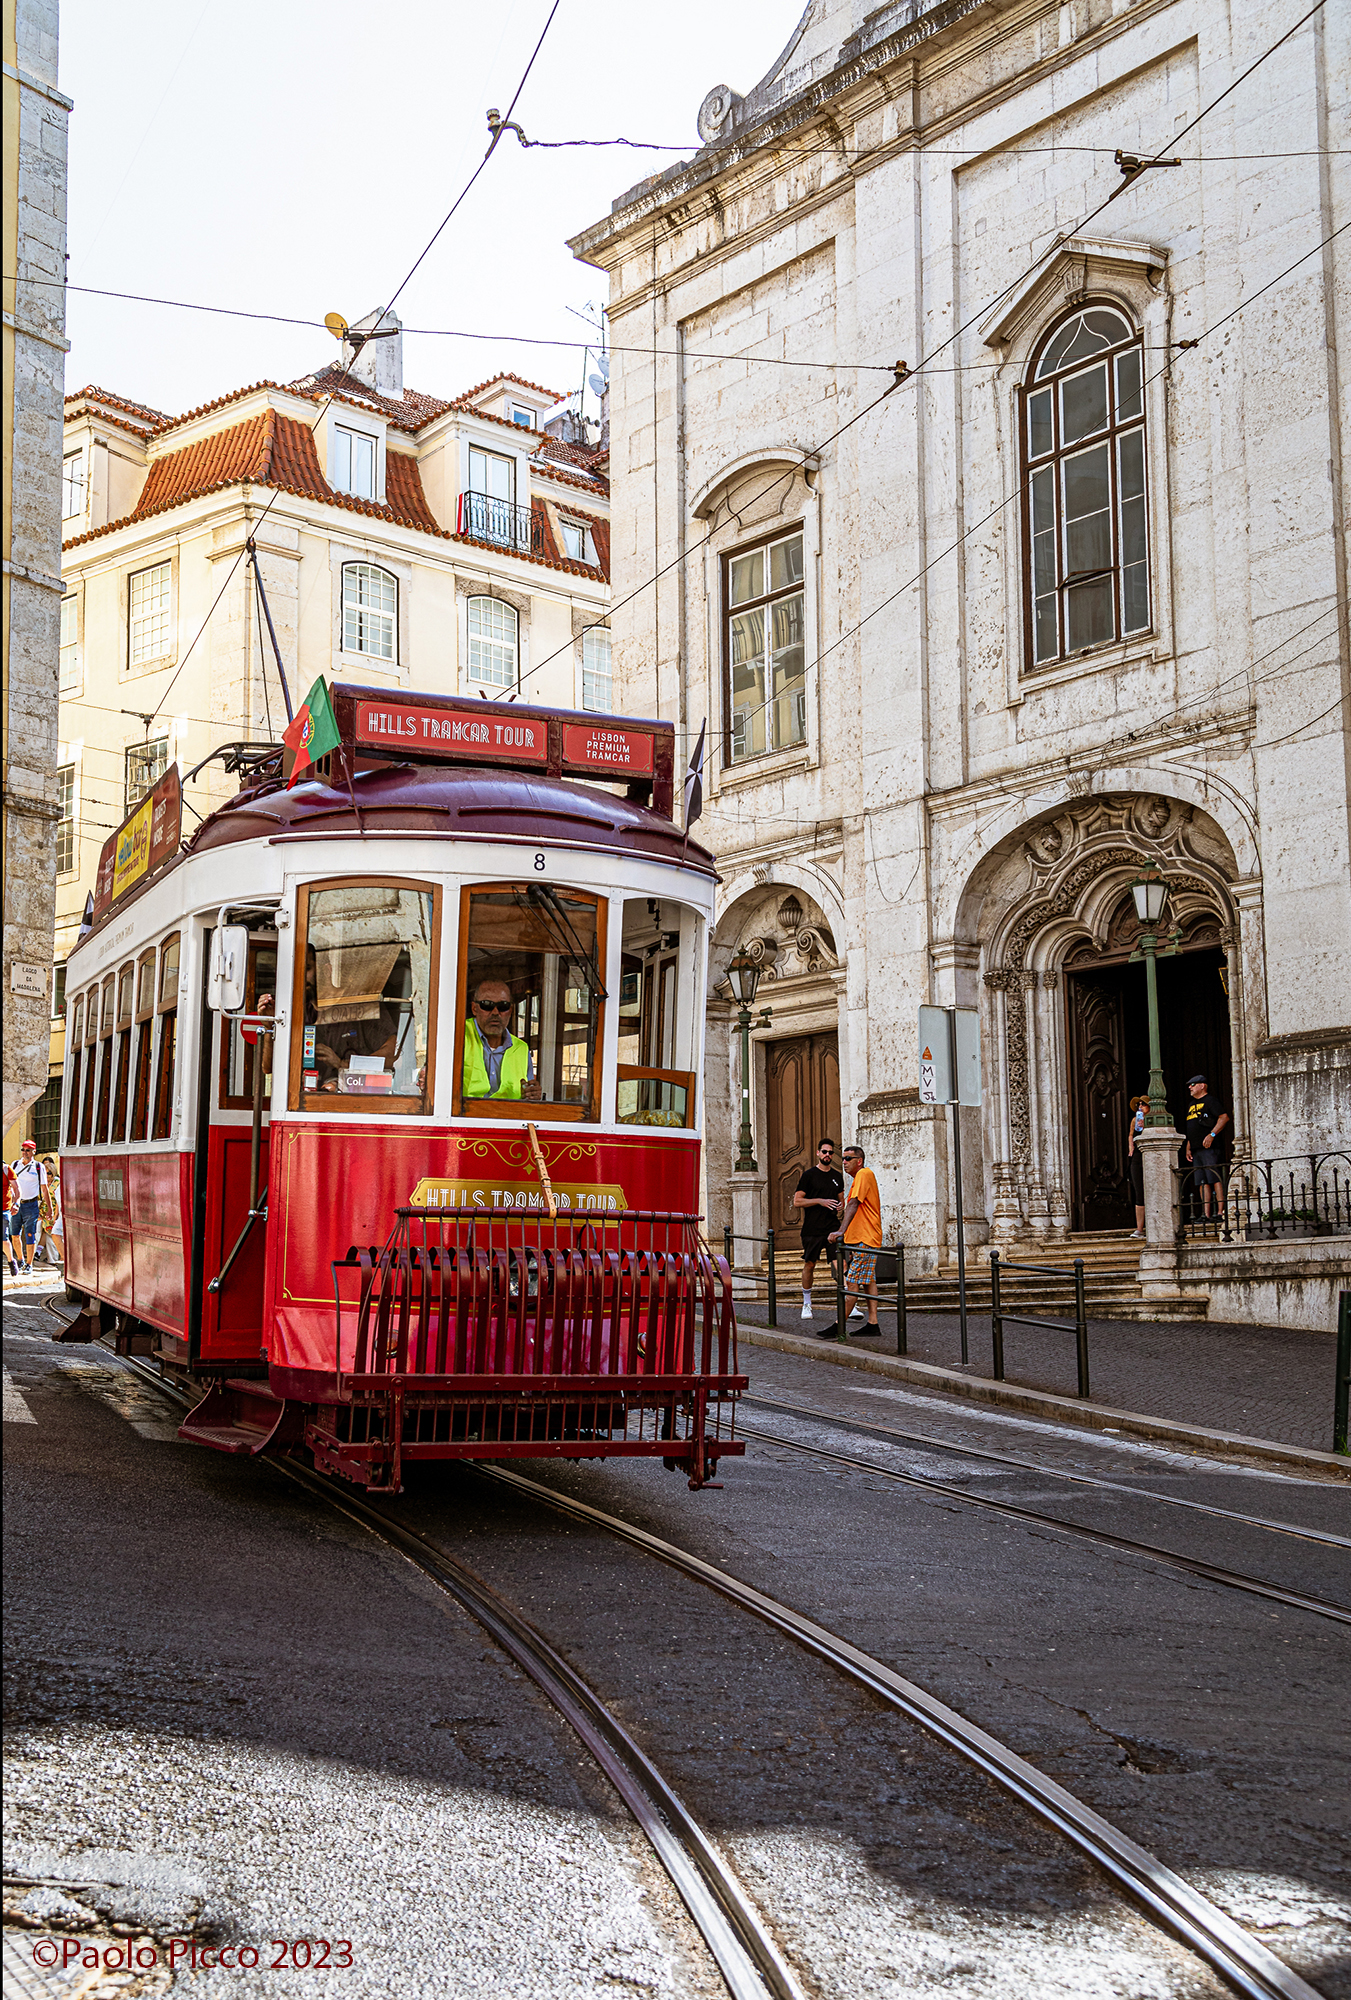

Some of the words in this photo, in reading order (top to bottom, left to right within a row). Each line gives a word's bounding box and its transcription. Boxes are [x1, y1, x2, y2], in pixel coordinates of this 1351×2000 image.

[368, 712, 417, 736] HILLS
[421, 717, 490, 744] TRAMCAR
[494, 724, 535, 748] TOUR
[592, 731, 626, 744] LISBON
[586, 740, 630, 754] PREMIUM
[586, 750, 630, 763] TRAMCAR
[534, 853, 546, 871] 8
[921, 1065, 934, 1077] M
[346, 1077, 364, 1086] Col.
[923, 1077, 932, 1087] V
